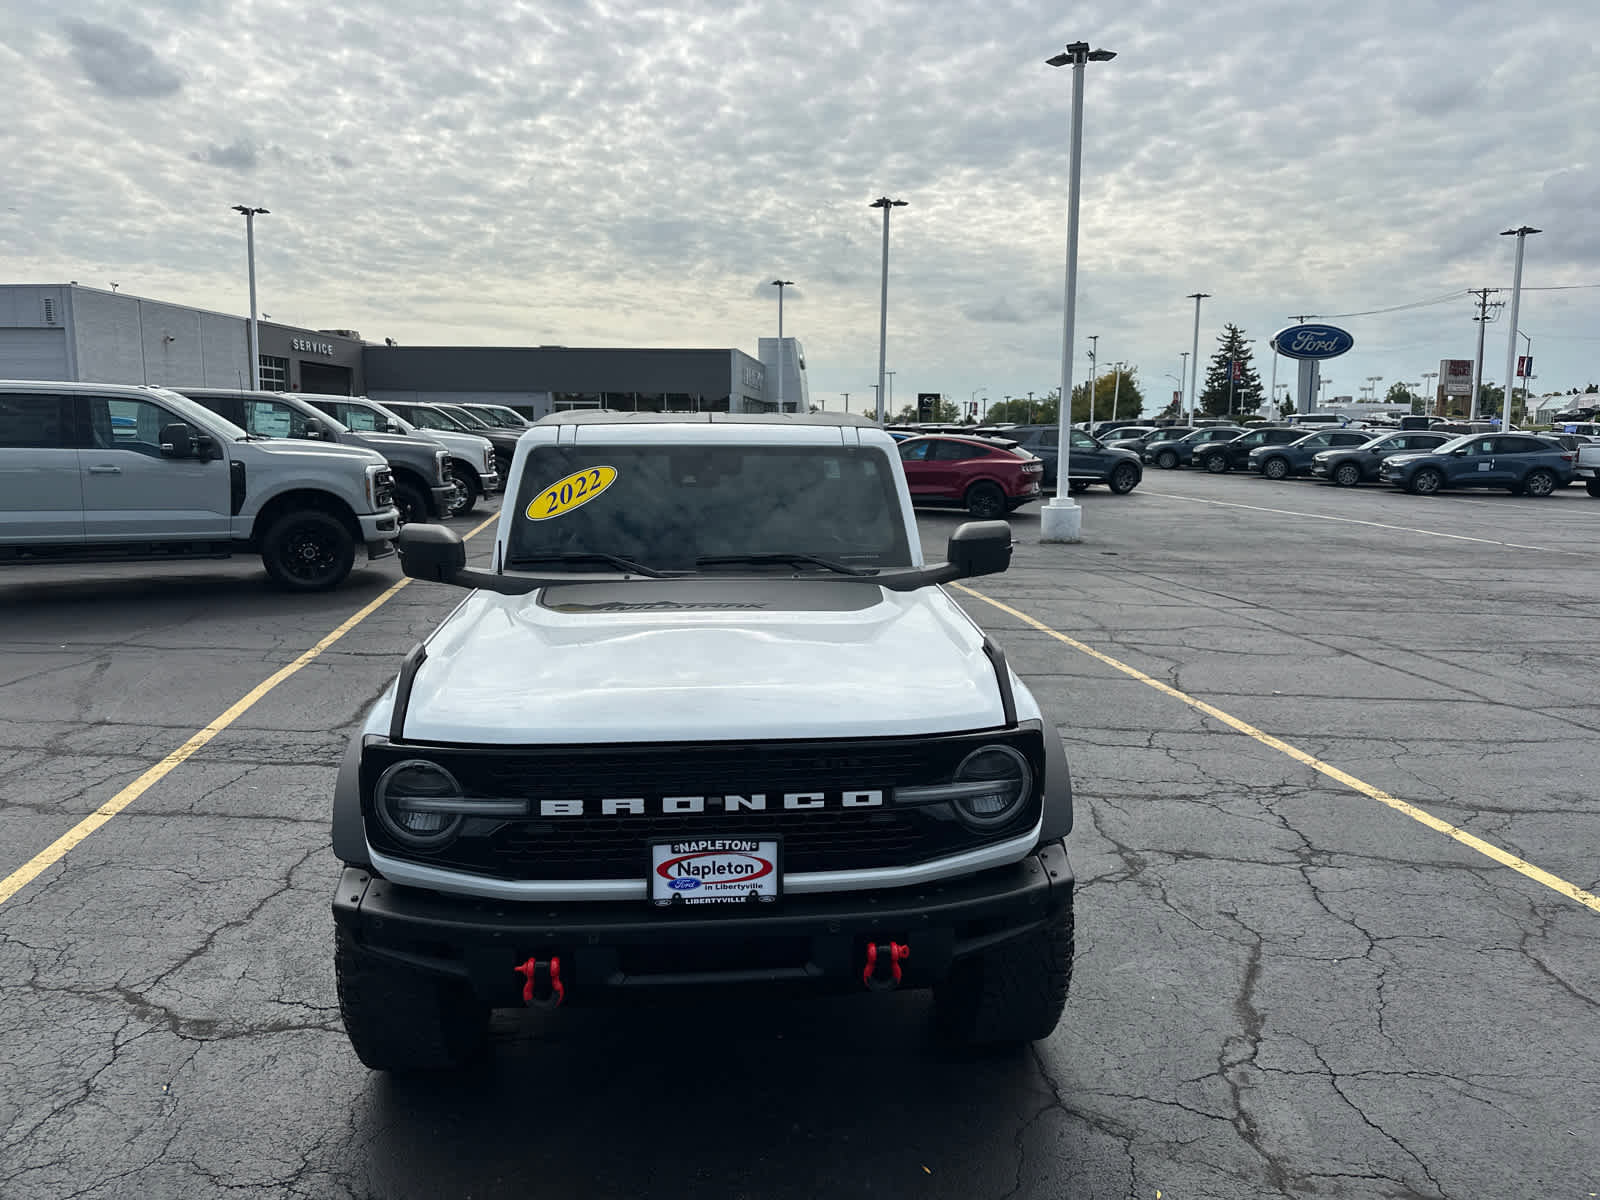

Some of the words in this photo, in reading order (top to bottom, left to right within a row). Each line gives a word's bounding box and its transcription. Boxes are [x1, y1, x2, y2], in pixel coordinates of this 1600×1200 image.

[292, 338, 333, 355] SERVICE
[1291, 330, 1339, 351] Ford
[545, 469, 602, 514] 2022
[540, 790, 883, 816] BRONCO
[679, 840, 752, 853] NAPLETON
[677, 861, 754, 879] Napleton
[674, 879, 695, 889] Ford
[715, 882, 764, 891] Libertyville
[685, 897, 746, 905] LIBERTYVILLE
